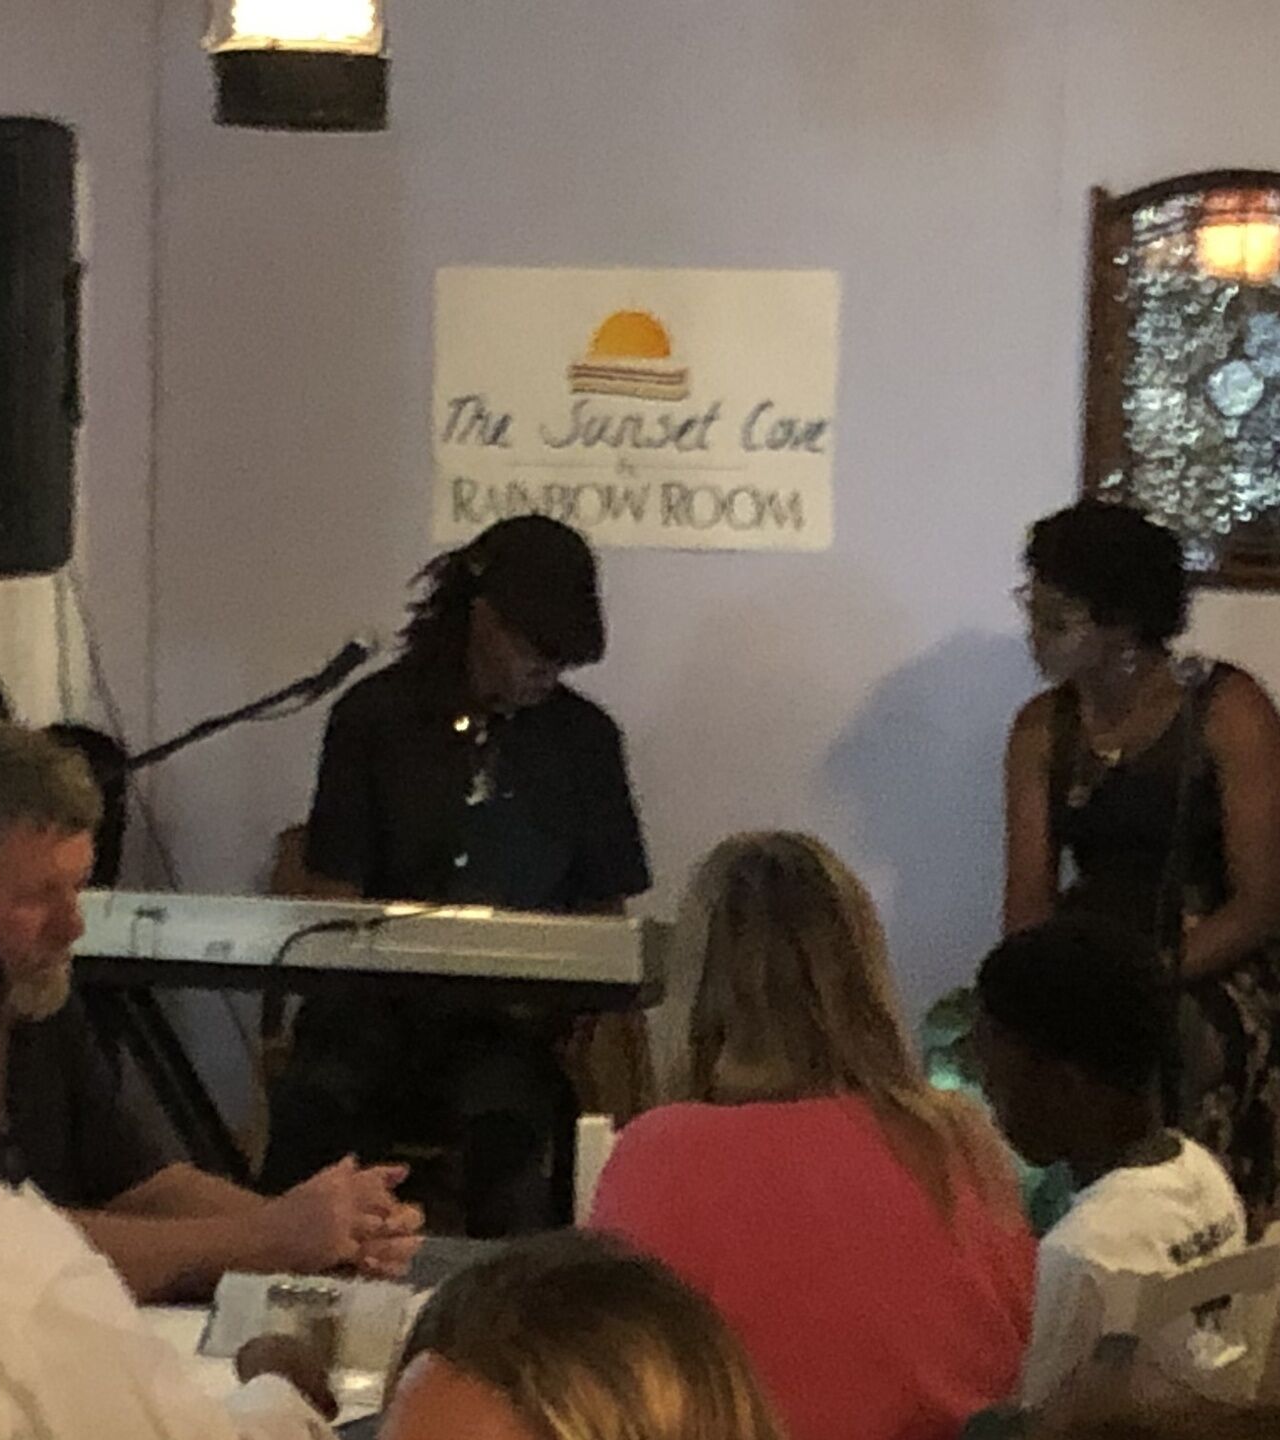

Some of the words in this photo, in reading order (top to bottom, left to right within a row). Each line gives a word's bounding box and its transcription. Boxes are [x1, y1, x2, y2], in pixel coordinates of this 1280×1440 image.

[440, 395, 513, 448] The
[539, 397, 722, 452] Sunset
[451, 476, 652, 526] RAINBOW
[660, 477, 807, 532] ROOM
